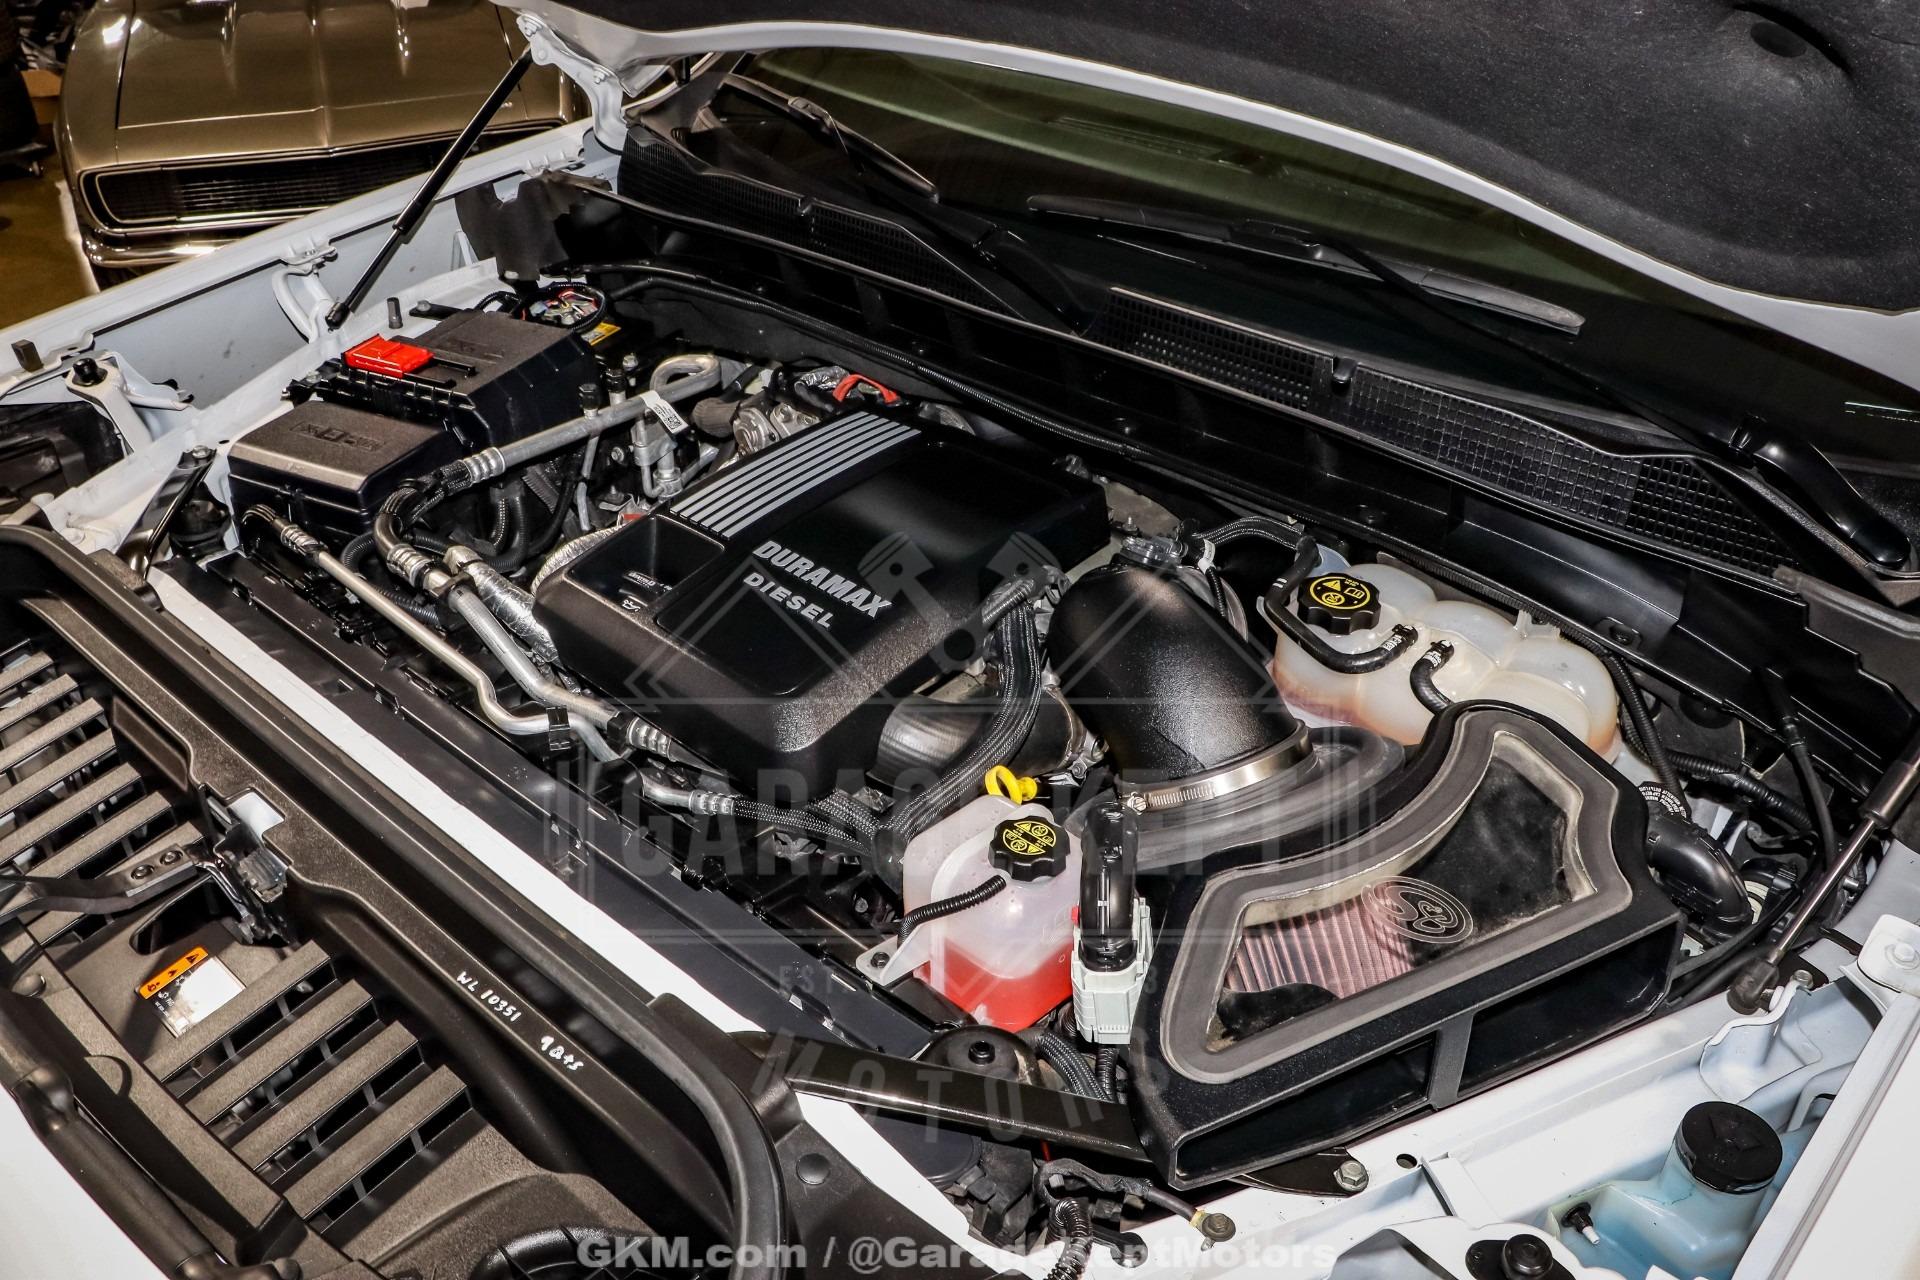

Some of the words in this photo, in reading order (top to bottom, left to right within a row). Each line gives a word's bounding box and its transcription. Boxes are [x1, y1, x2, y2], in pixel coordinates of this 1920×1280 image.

[743, 572, 834, 628] DIESEL
[752, 540, 892, 619] DURAMAX
[456, 971, 479, 992] WL
[480, 989, 522, 1022] 10351
